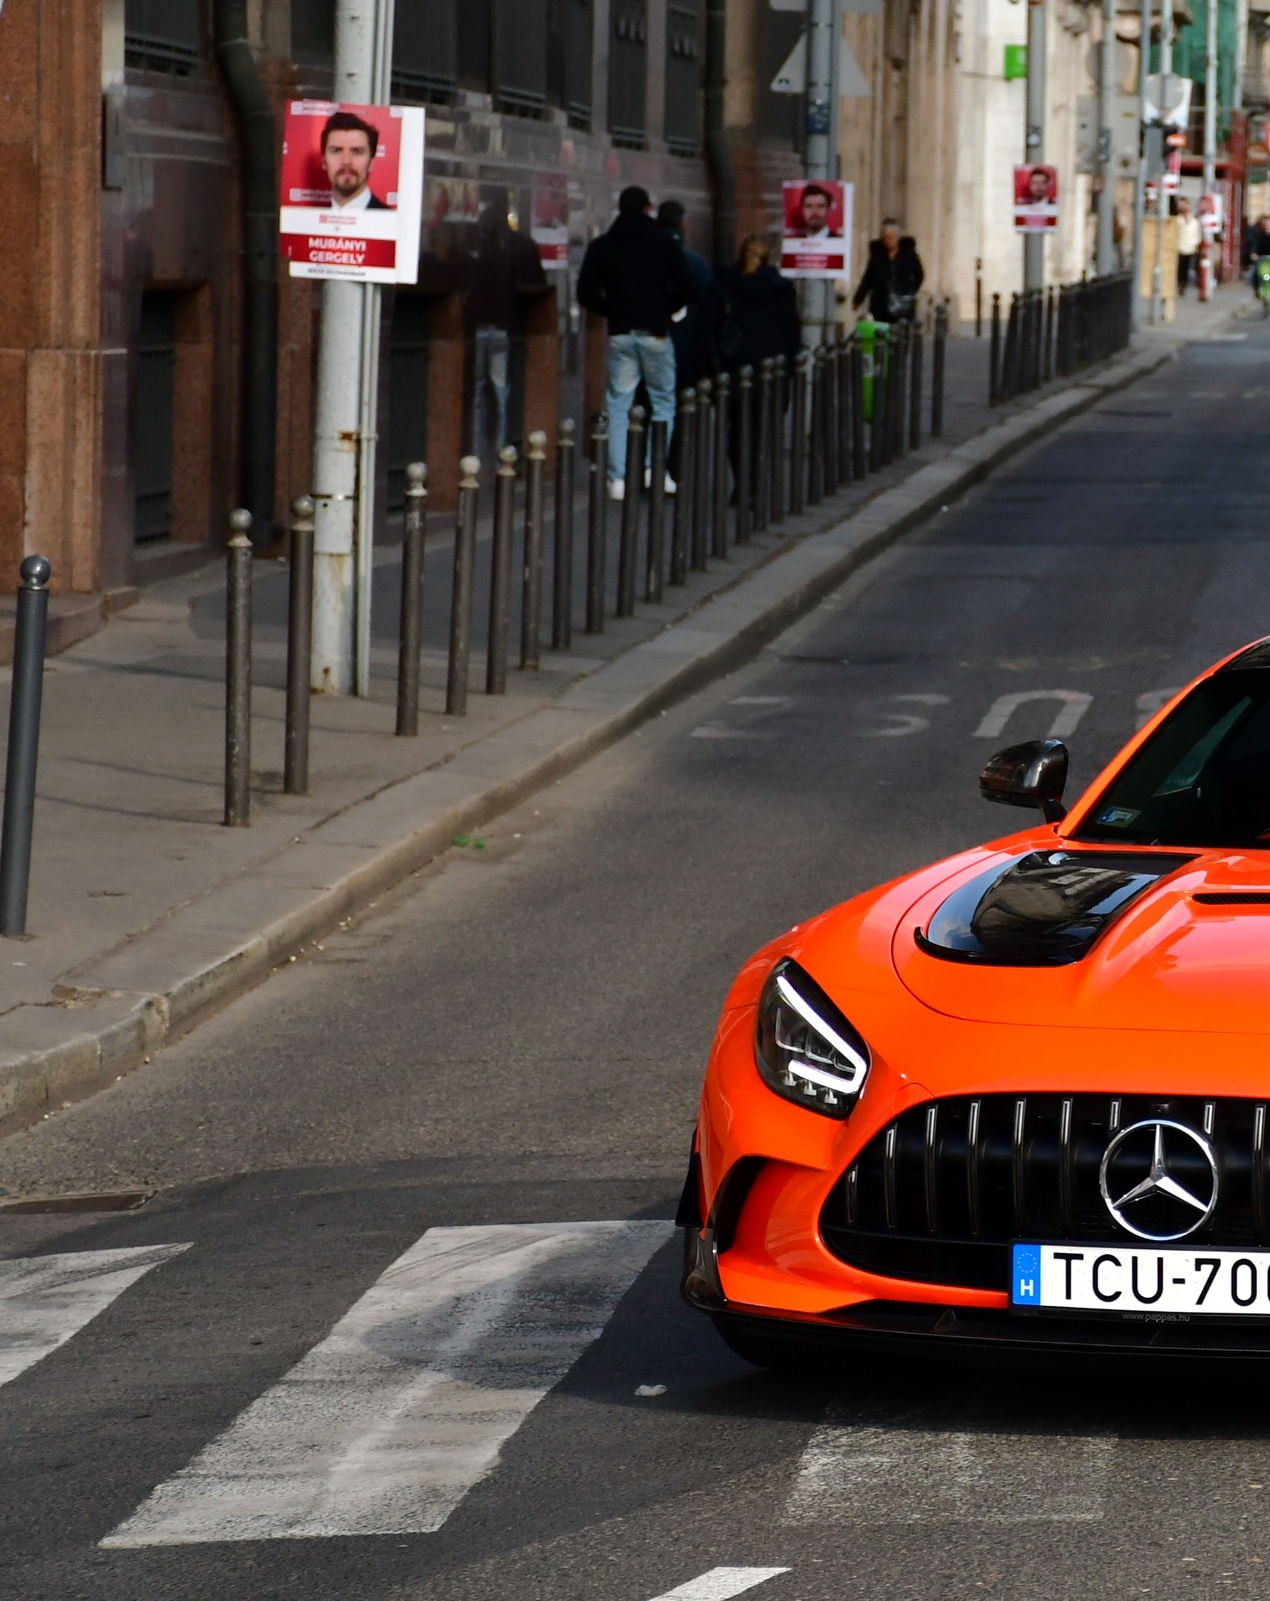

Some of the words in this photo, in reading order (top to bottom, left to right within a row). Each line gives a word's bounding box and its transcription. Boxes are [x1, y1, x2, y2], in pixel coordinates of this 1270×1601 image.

[308, 236, 367, 252] MURÁNYI
[309, 250, 366, 265] GERGELY
[1020, 1279, 1034, 1297] H
[1122, 1313, 1190, 1323] www.pappas.hu
